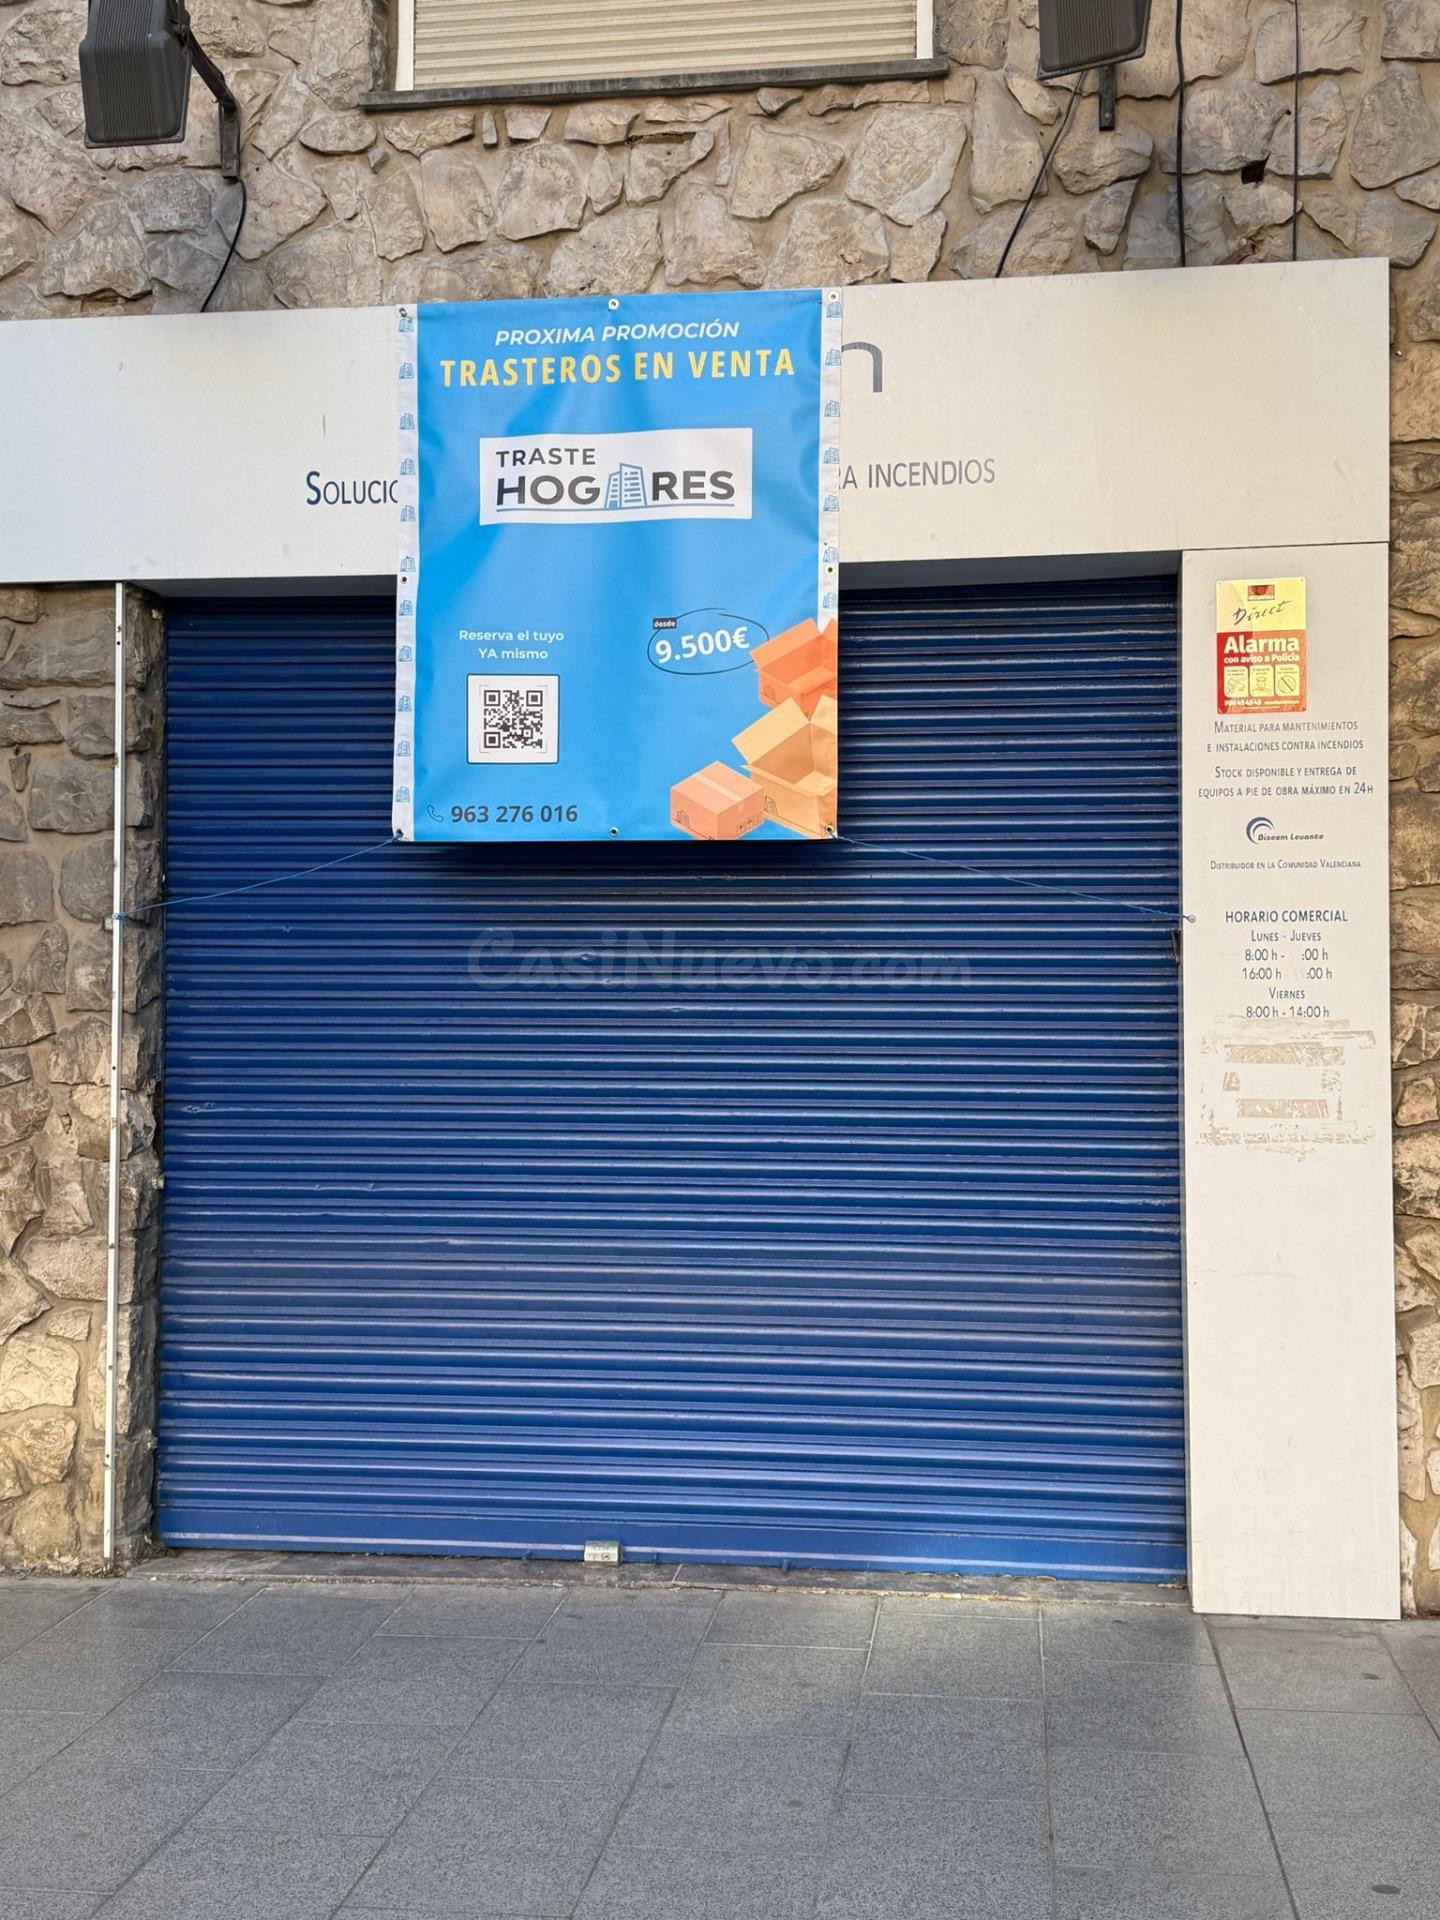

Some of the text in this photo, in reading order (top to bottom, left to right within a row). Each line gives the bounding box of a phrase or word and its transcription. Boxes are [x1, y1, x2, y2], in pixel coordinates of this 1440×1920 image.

[495, 318, 740, 347] PROXIMA PROMOCIÓN
[440, 348, 795, 388] TRASTEROS EN VENTA
[496, 447, 596, 468] TRASTE
[868, 458, 996, 488] INCENDIOS
[653, 619, 676, 629] desde
[459, 630, 565, 645] Reserva el tuyo
[655, 626, 750, 664] 9.500€
[1224, 635, 1299, 654] Alarma
[478, 648, 549, 660] YA mismo
[1224, 656, 1239, 664] con
[1240, 654, 1263, 664] aviso
[1259, 723, 1280, 732] PARA
[1207, 740, 1364, 752] E INSTALACIONES CONTRA INCENDIOS
[1246, 767, 1295, 778] DISPONIBLE
[1304, 766, 1342, 777] ENTREGA
[1346, 766, 1357, 776] DE
[1198, 787, 1234, 798] EQUIPOS
[1236, 787, 1242, 797] A
[1246, 787, 1258, 796] PIE
[1261, 787, 1272, 796] DE
[1275, 786, 1298, 796] OBRA
[1301, 783, 1336, 795] MÁXIMO
[1339, 785, 1350, 795] EN
[451, 804, 578, 824] 963 276 016
[1225, 910, 1348, 923] HORARIO COMERCIAL
[1245, 949, 1268, 961] 8:00
[1271, 949, 1277, 960] h
[1322, 949, 1329, 960] h
[1242, 968, 1272, 980] 16:00
[1275, 968, 1282, 979] h
[1326, 968, 1332, 979] h
[1246, 1006, 1270, 1018] 8:00
[1273, 1006, 1279, 1018] h
[1289, 1006, 1321, 1018] 14:00
[1323, 1006, 1330, 1018] h
